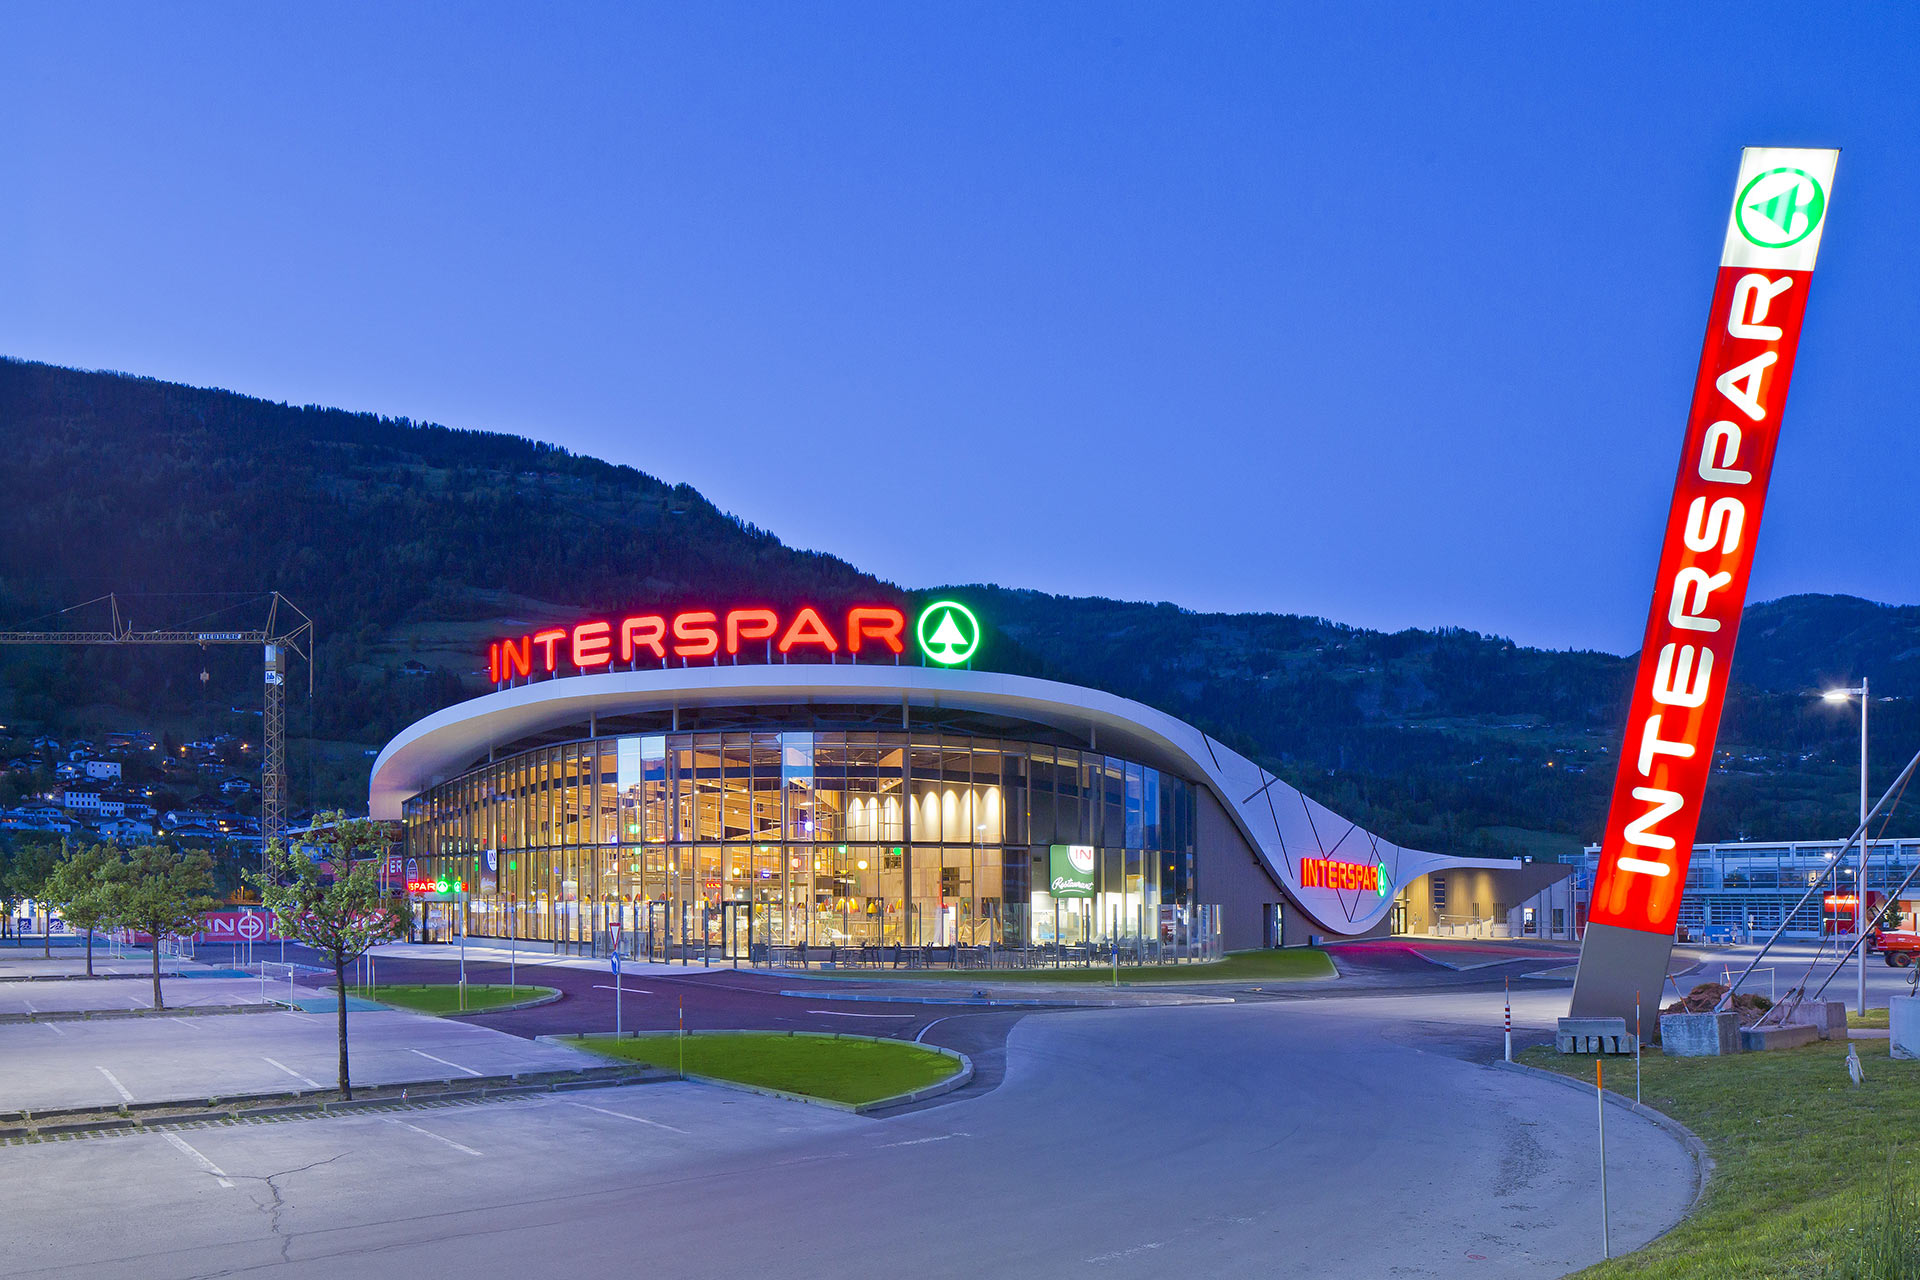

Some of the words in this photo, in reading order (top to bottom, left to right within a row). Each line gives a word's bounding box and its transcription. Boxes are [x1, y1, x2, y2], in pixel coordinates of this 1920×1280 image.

[1617, 272, 1793, 877] INTERSPAR
[489, 607, 904, 683] INTERSPAR
[1075, 849, 1092, 860] IN
[1052, 876, 1094, 890] Restaurant
[1301, 857, 1378, 890] INTERSPAR
